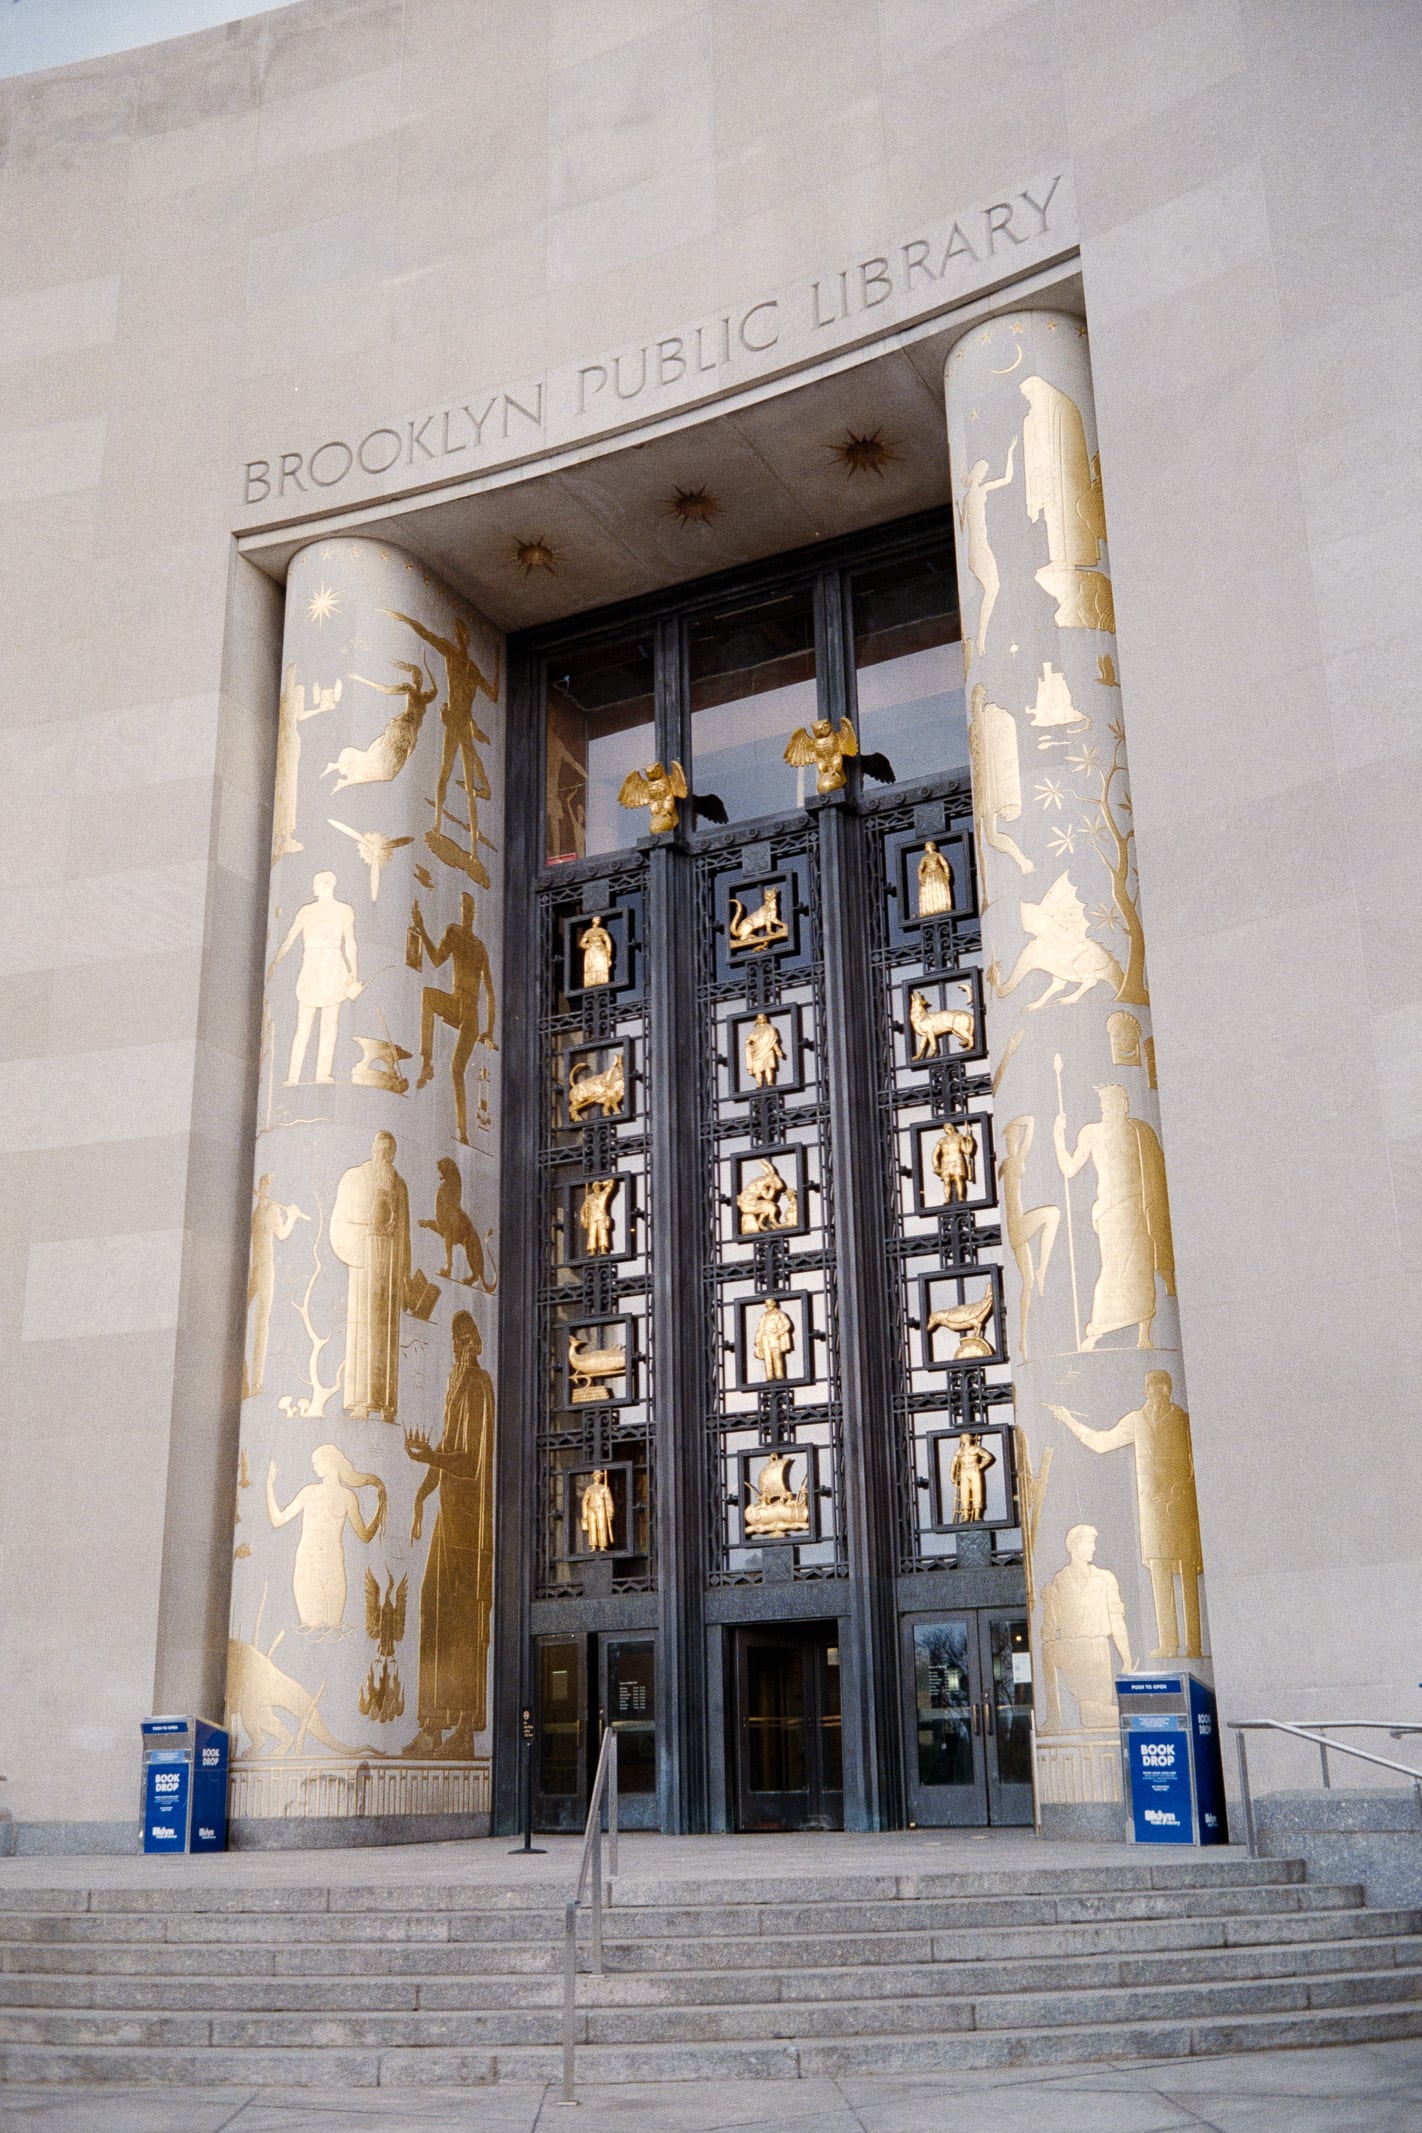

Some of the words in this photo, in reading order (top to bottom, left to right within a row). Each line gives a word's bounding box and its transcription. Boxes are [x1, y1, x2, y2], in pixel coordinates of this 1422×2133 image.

[243, 382, 543, 505] BROOKLYN
[575, 299, 780, 416] PUBLIC
[810, 174, 1063, 330] LIBRARY
[202, 1748, 220, 1757] BOOK
[1140, 1744, 1175, 1755] BOOK
[202, 1757, 219, 1766] DROP
[1142, 1755, 1175, 1766] DROP
[155, 1773, 180, 1783] BOOK
[155, 1783, 179, 1792] DROP
